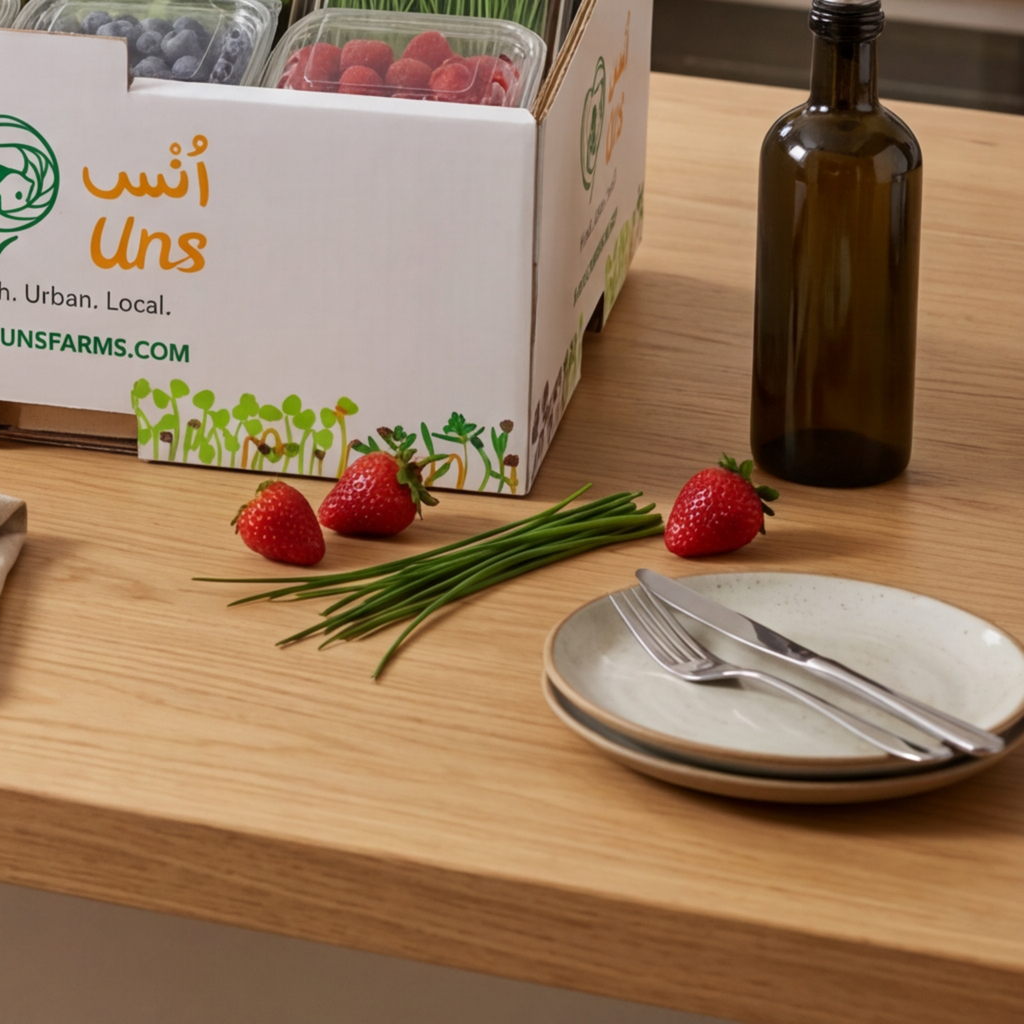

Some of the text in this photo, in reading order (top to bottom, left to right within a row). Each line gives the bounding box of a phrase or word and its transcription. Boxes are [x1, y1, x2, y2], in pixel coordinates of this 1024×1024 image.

[90, 215, 209, 274] Uns
[25, 283, 98, 310] Urban.
[106, 290, 172, 316] Local.
